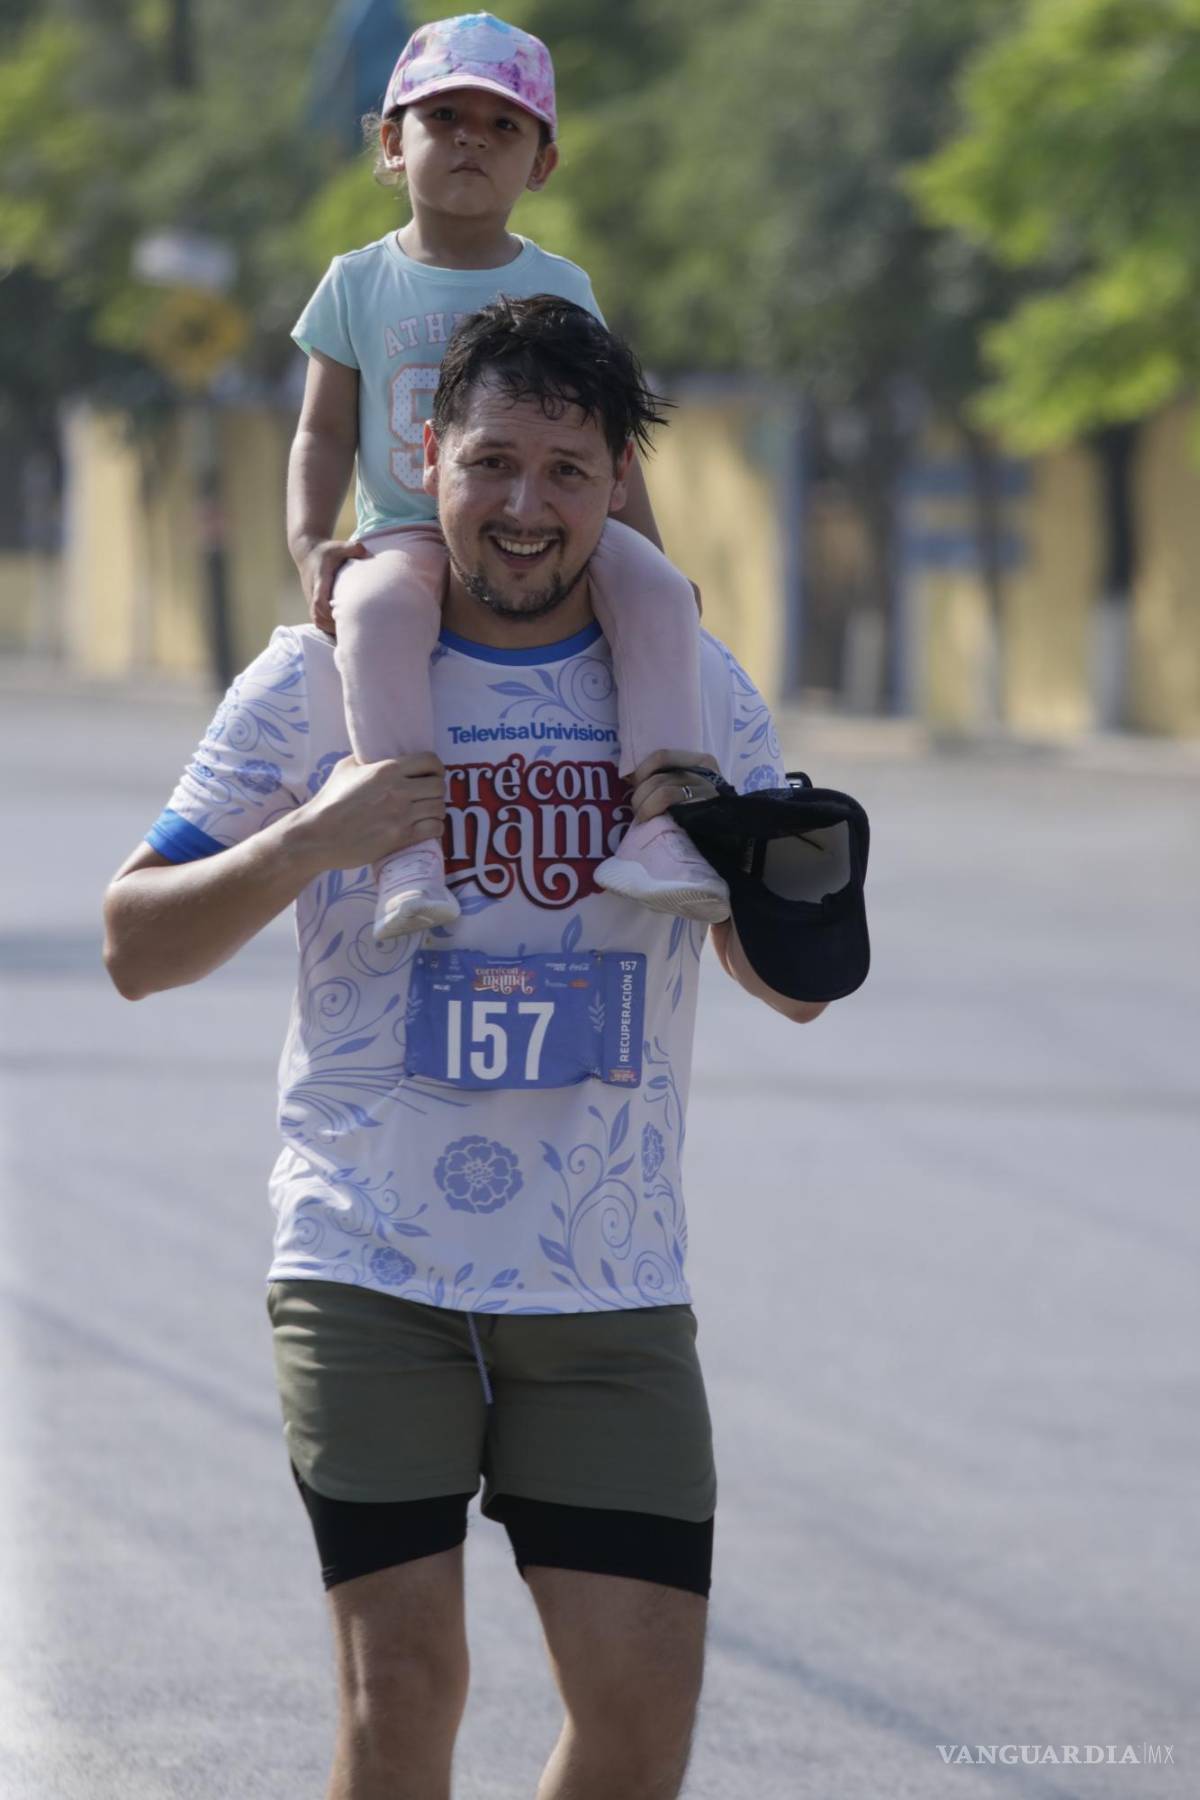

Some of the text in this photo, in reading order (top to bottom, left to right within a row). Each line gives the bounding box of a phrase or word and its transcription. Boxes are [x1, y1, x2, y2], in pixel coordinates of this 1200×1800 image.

[448, 722, 618, 744] TelevisaUnivision
[527, 765, 612, 801] con
[619, 960, 637, 971] 157
[620, 974, 632, 1063] RECUPERACIÓN
[447, 1000, 555, 1081] 157
